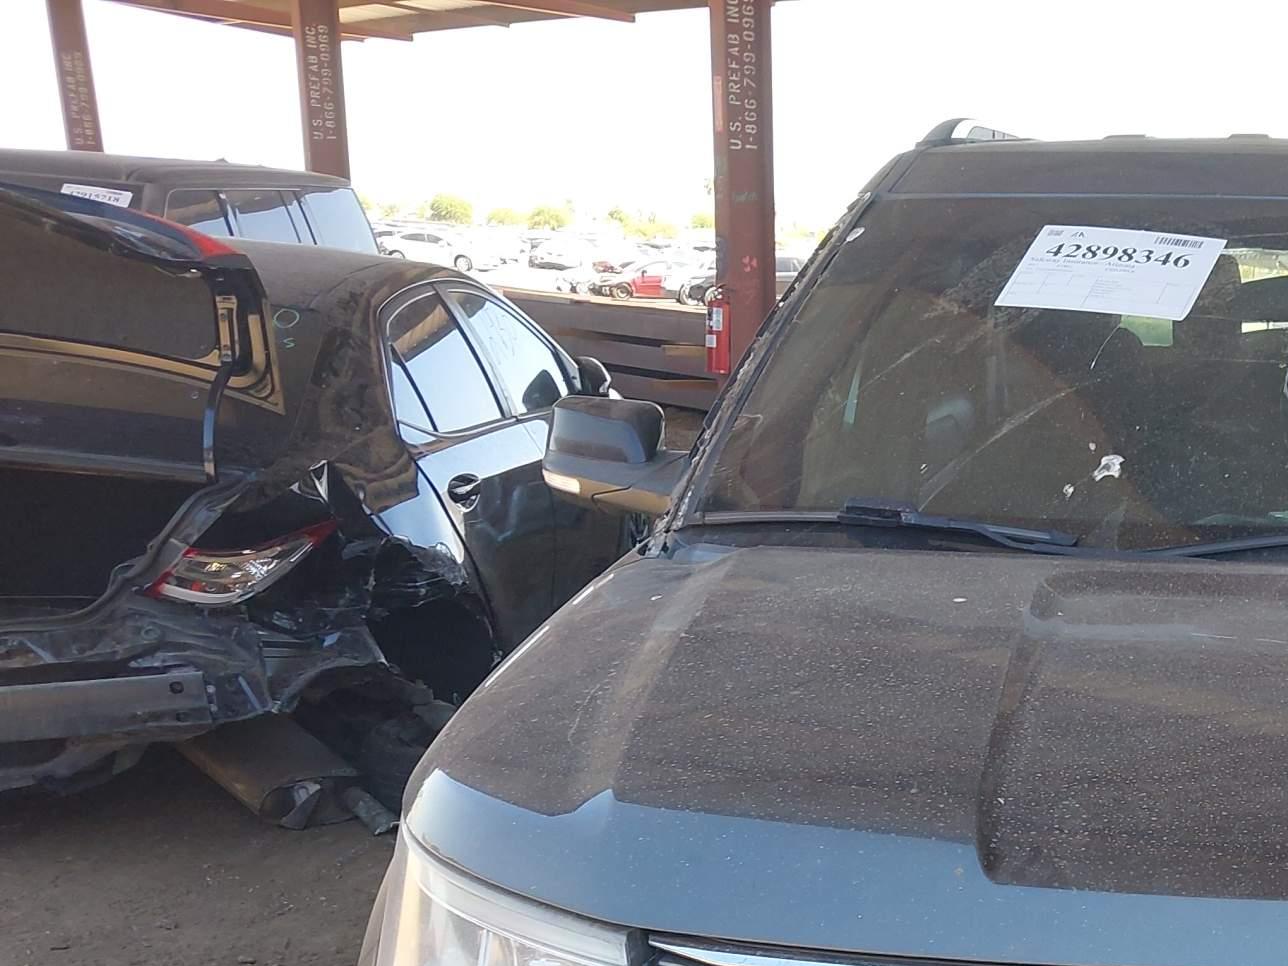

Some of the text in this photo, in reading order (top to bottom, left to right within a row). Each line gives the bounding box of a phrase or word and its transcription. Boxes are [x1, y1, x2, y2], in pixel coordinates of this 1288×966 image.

[307, 55, 321, 107] PREFAB
[728, 33, 741, 105] PREFAB
[742, 0, 757, 149] 1-866-799-096
[730, 116, 742, 150] U.S.
[1046, 242, 1194, 269] 42898346
